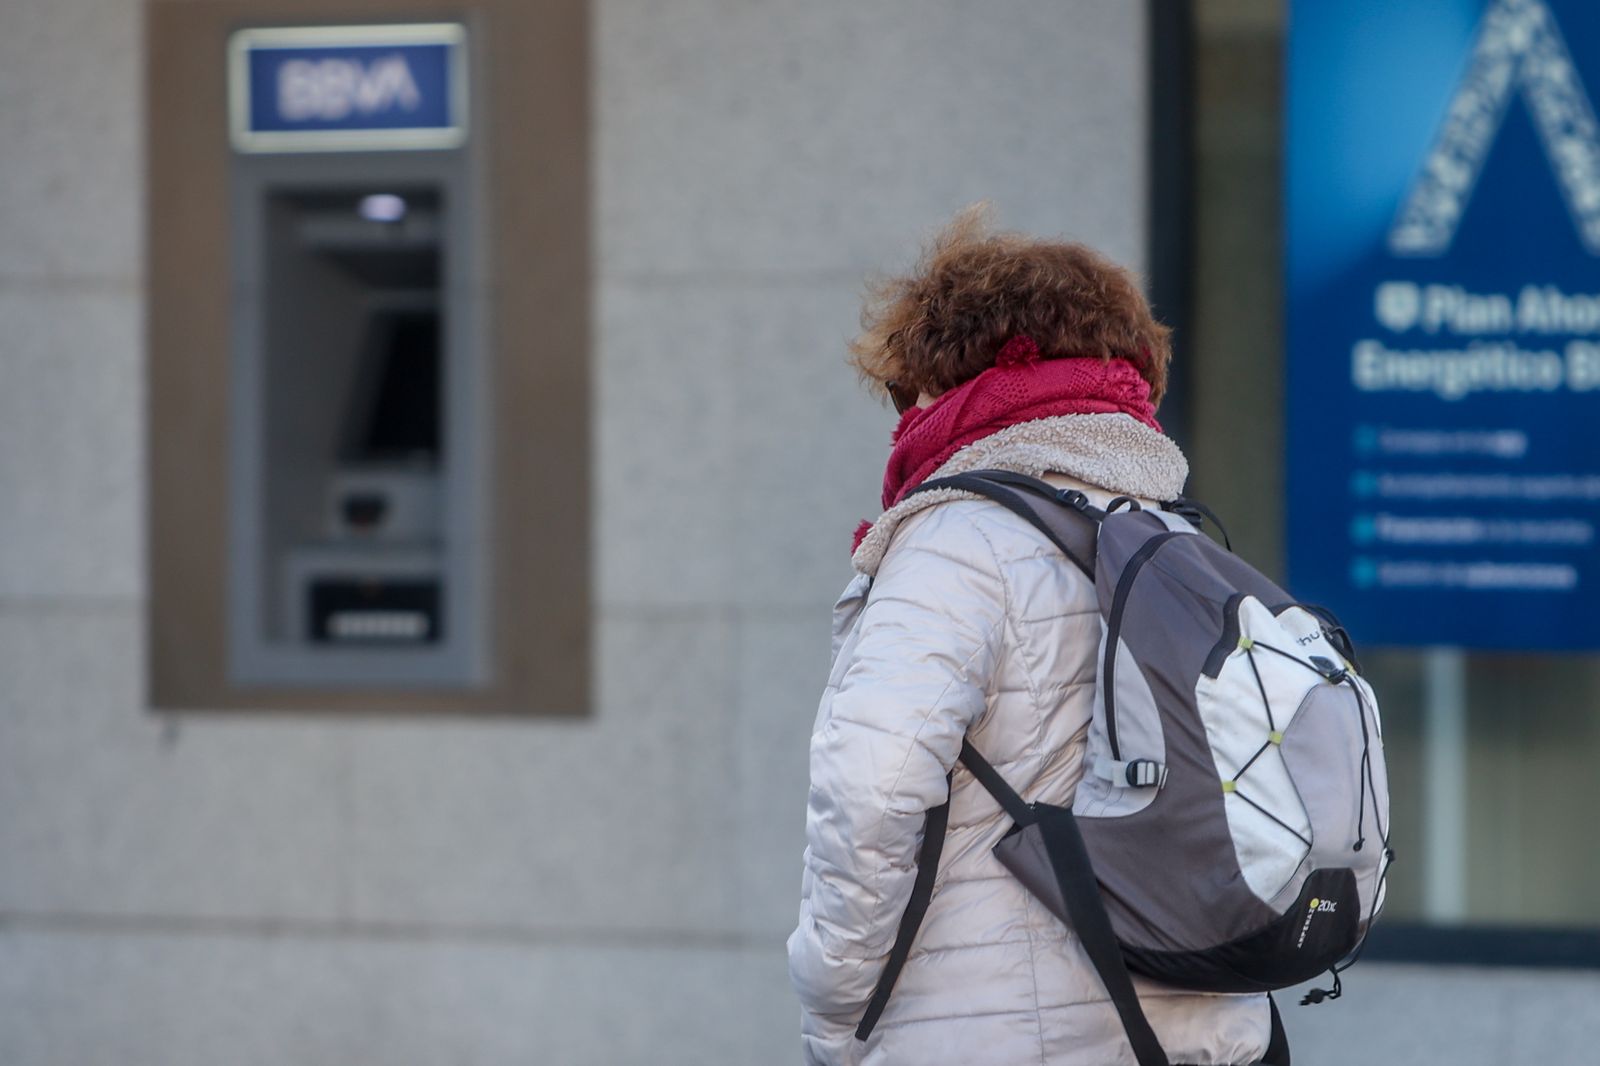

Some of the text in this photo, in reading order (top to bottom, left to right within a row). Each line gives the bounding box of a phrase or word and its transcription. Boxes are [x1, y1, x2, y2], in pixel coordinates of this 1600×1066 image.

[278, 55, 420, 121] BBVA
[1422, 284, 1513, 334] Plan
[1352, 339, 1562, 400] Energético
